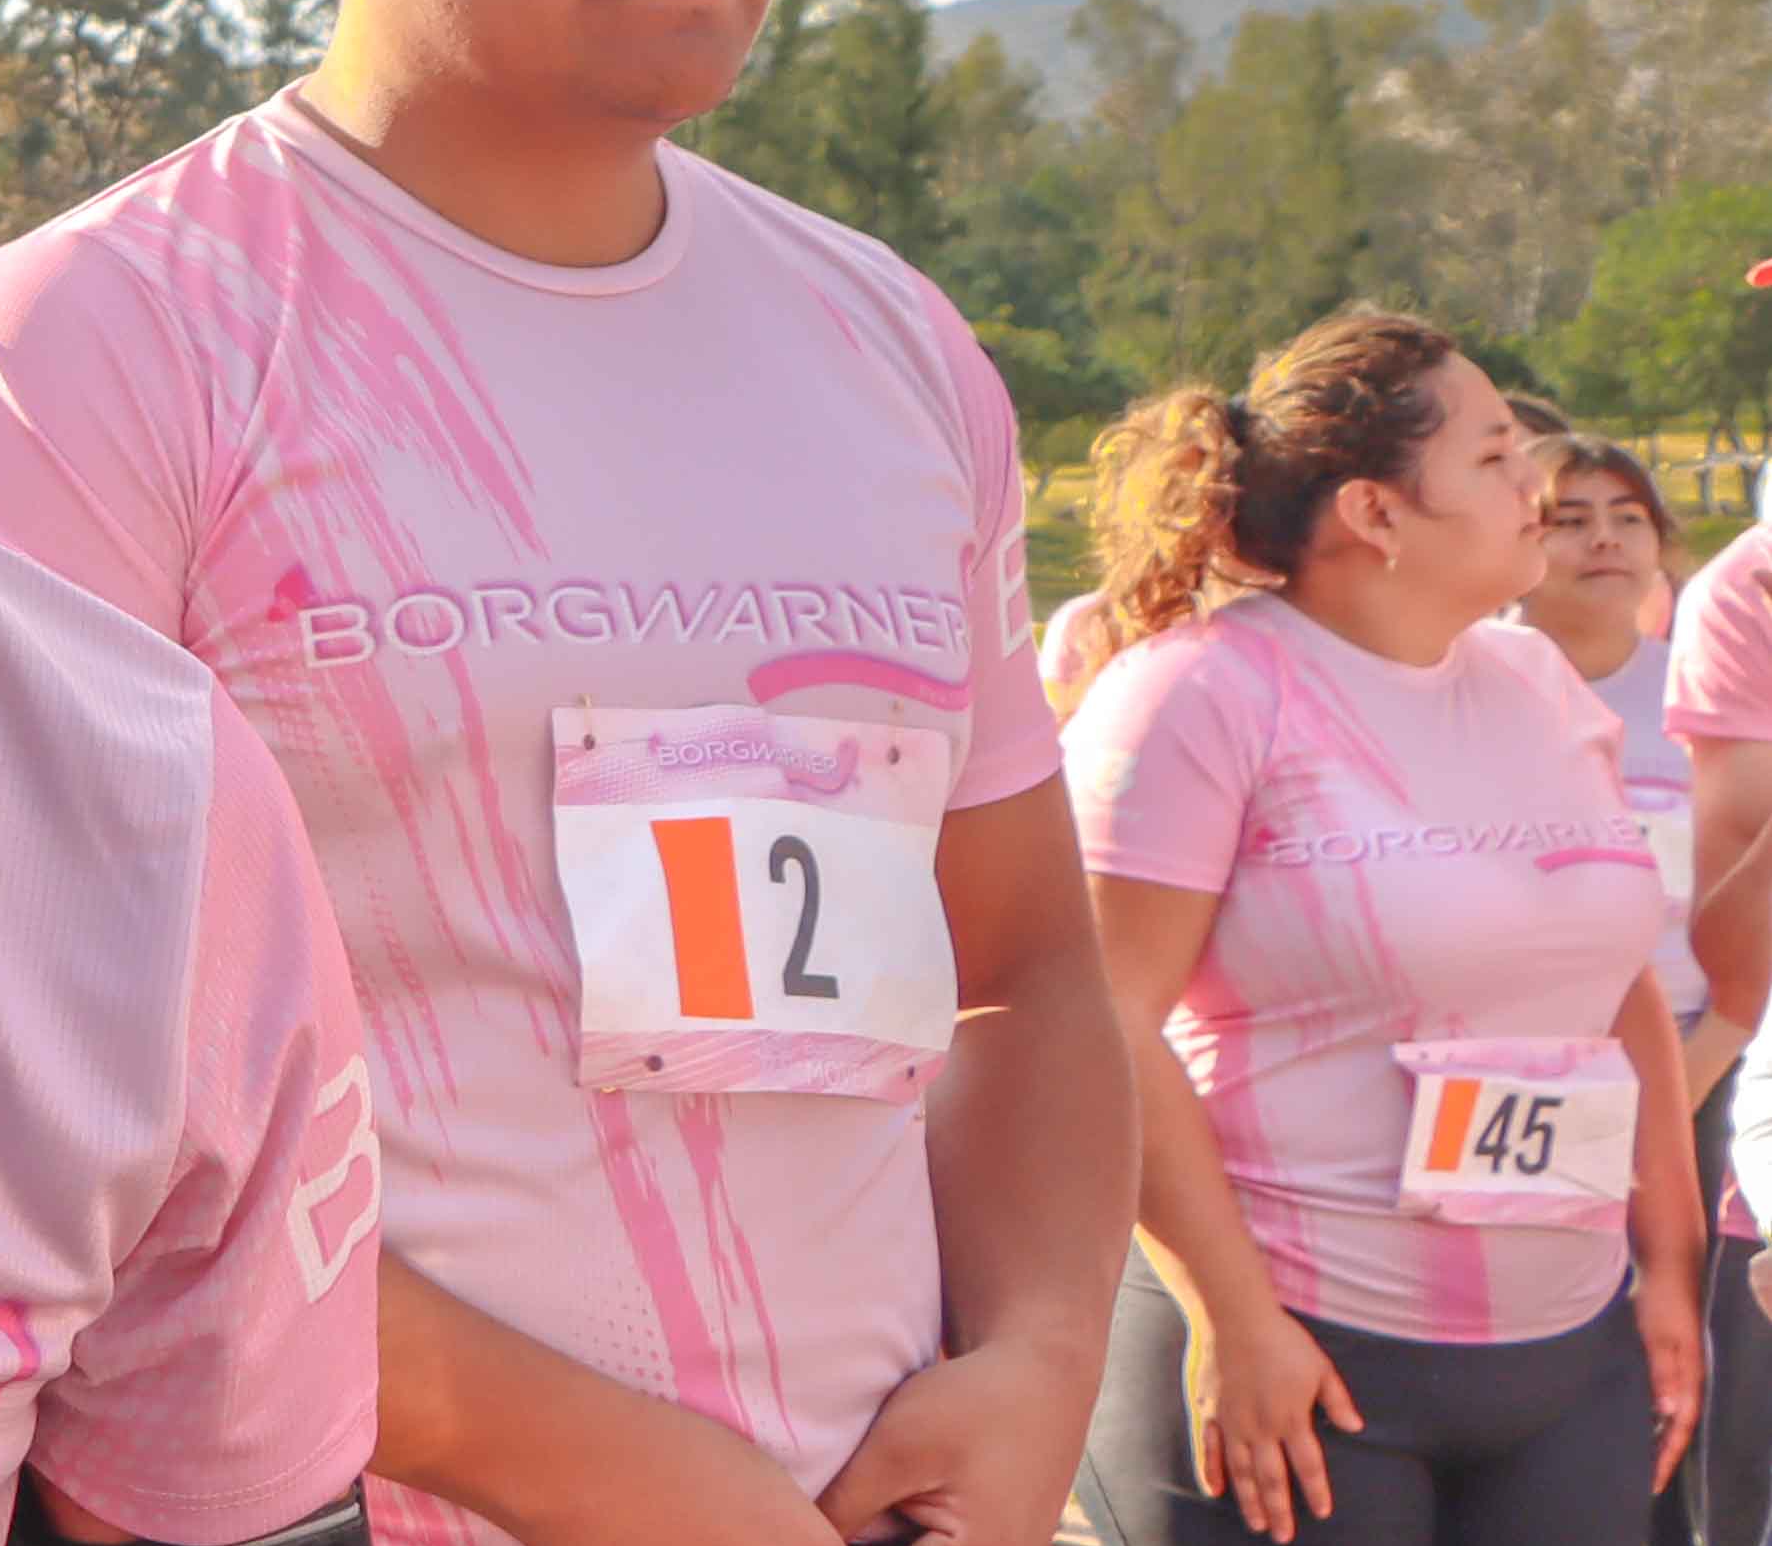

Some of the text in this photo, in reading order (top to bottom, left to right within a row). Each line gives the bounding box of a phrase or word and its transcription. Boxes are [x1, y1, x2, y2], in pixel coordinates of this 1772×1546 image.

[298, 585, 969, 669] BORGWARNER
[658, 739, 838, 774] BORGWARNER
[769, 835, 840, 999] 2
[1475, 1093, 1563, 1174] 45
